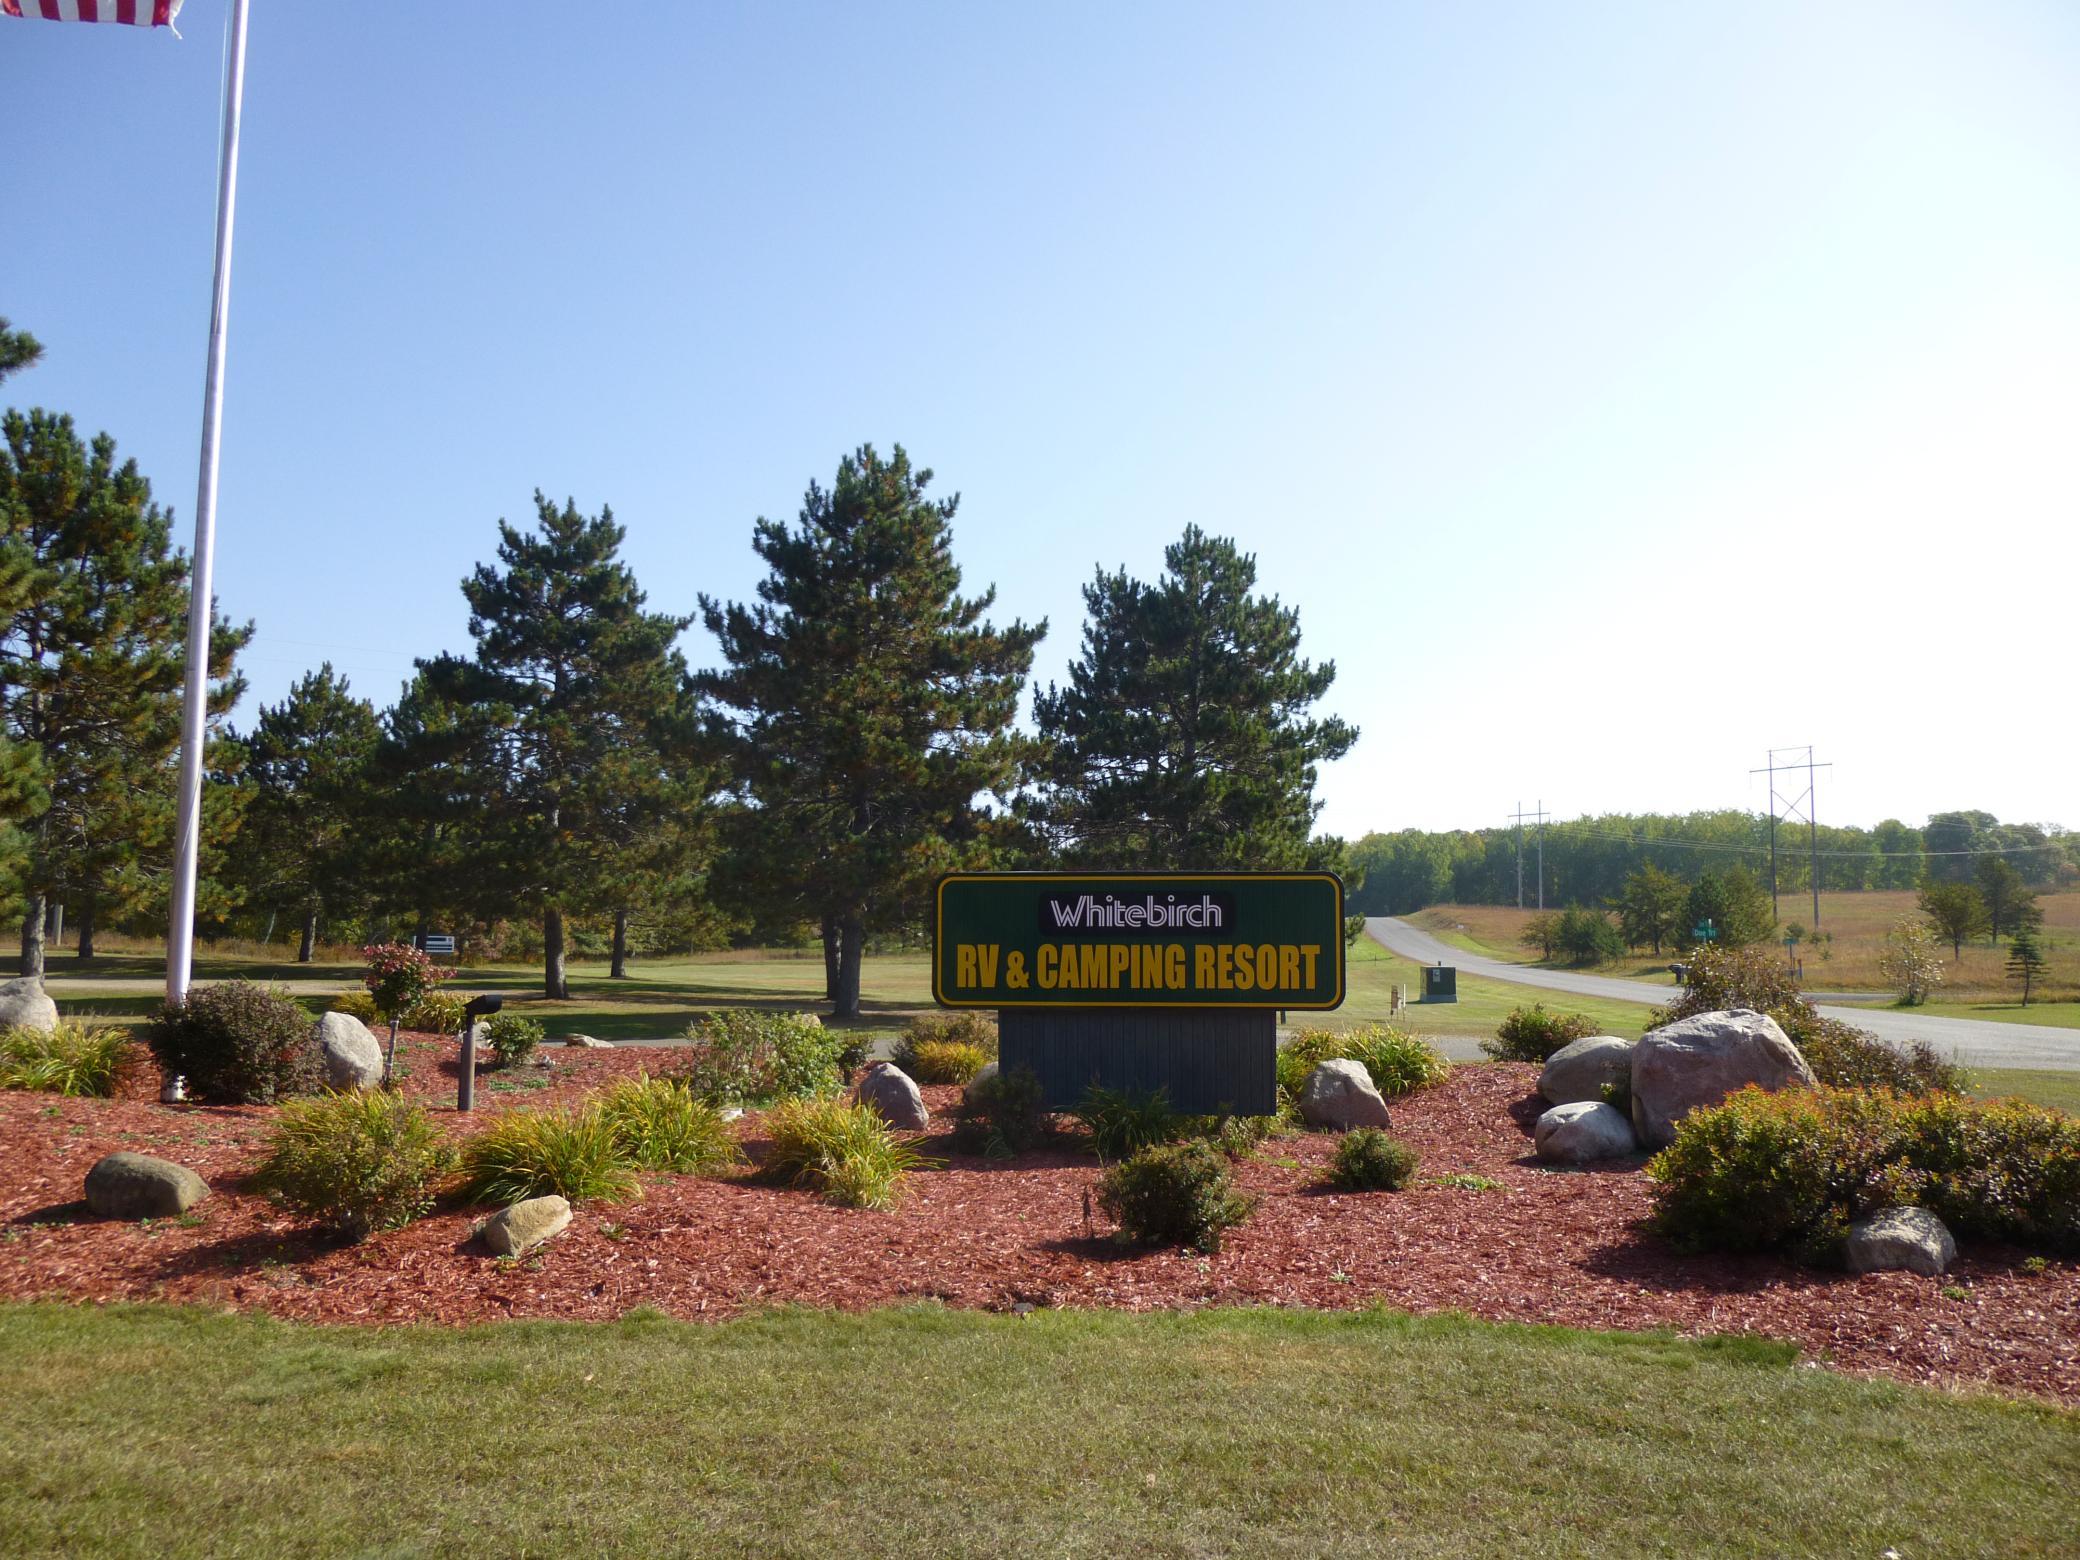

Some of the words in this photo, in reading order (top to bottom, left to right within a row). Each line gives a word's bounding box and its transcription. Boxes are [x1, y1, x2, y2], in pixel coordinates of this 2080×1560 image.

[1050, 895, 1222, 928] Whitebirch
[956, 944, 999, 988] RV
[1006, 950, 1030, 989] &
[1037, 943, 1186, 990] CAMPING
[1195, 943, 1321, 990] RESORT
